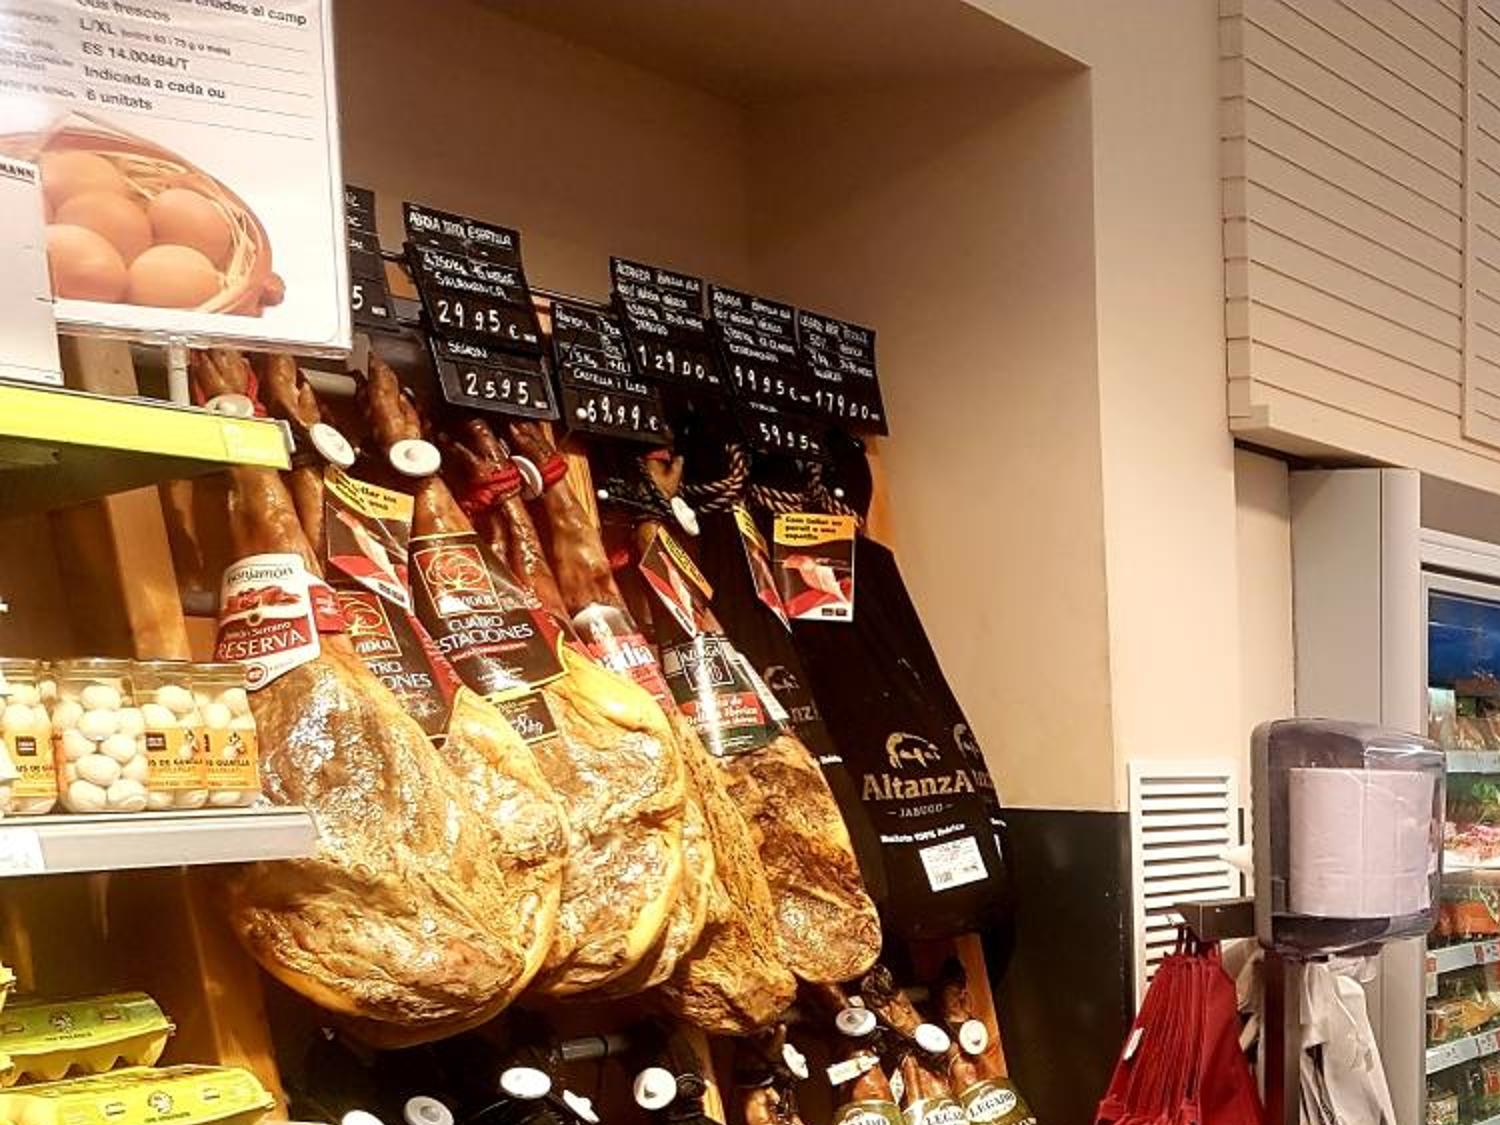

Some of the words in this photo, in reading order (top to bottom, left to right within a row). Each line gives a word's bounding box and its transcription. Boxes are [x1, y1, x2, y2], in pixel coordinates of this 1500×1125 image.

[113, 1, 171, 23] frescos
[268, 9, 307, 26] camp
[79, 17, 117, 36] L/XL
[82, 41, 103, 56] ES
[84, 65, 150, 88] Indicada
[154, 79, 164, 89] a
[167, 81, 203, 97] cada
[207, 87, 226, 99] ou
[100, 92, 153, 110] unitats
[861, 769, 975, 801] AltanzA
